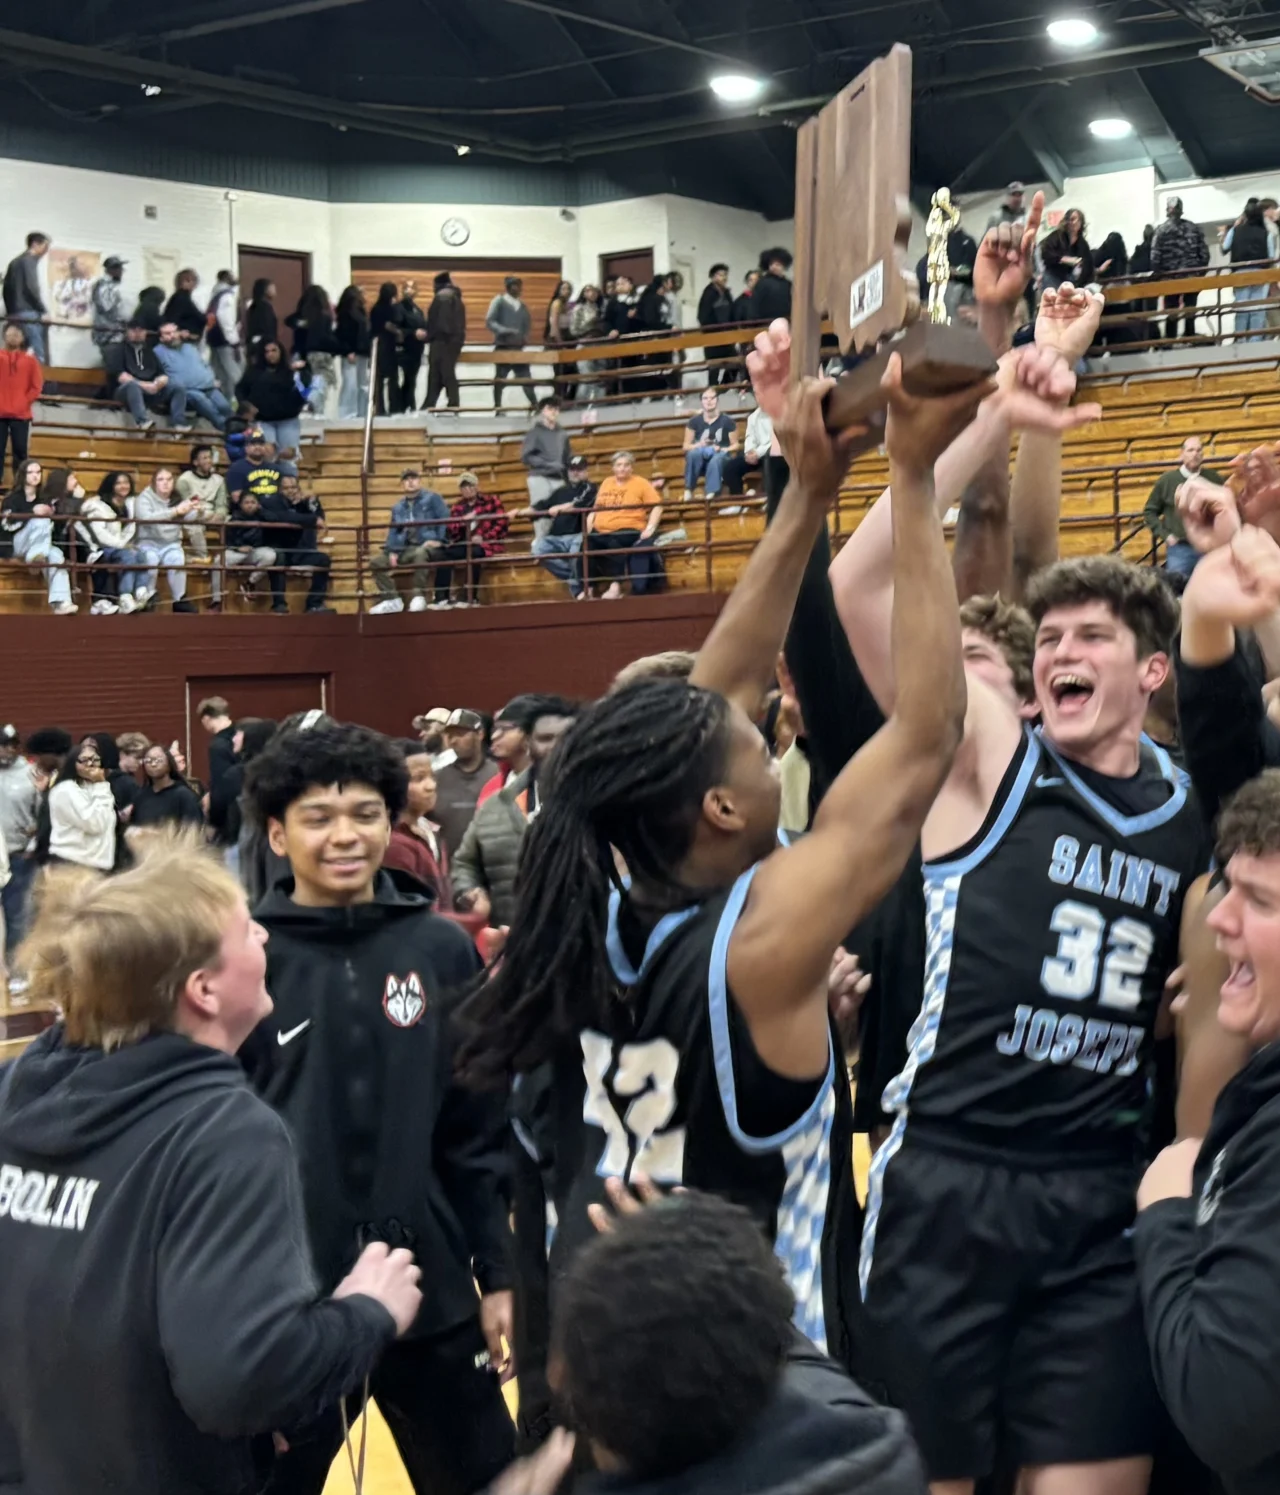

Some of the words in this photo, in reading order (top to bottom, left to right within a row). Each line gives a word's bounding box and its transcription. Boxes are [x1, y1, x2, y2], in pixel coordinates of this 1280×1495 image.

[1048, 834, 1181, 916] SAINT
[1040, 899, 1155, 1012] 32
[0, 1163, 100, 1231] BOLIN
